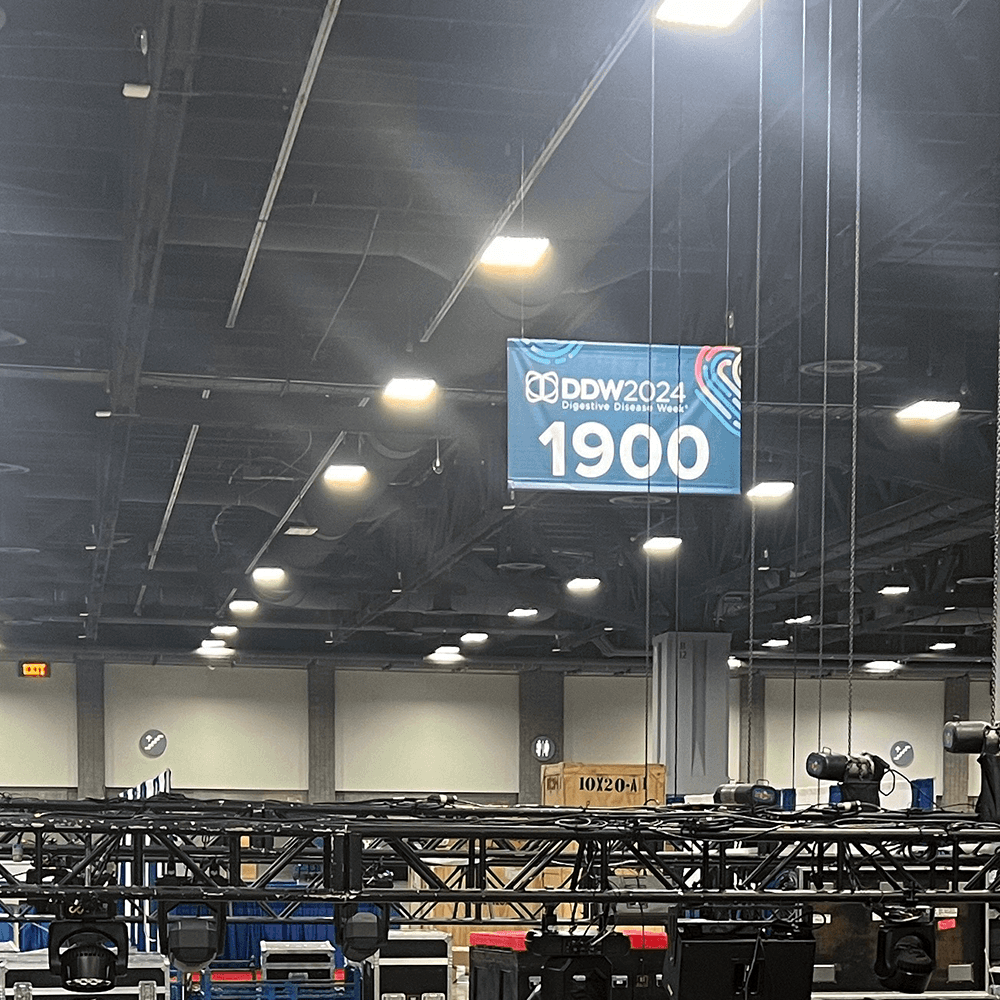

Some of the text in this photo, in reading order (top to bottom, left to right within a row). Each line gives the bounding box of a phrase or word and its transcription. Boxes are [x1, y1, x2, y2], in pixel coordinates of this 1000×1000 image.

[561, 378, 686, 403] DDW2024
[562, 400, 610, 411] Digestive
[614, 402, 653, 412] Disease
[538, 421, 710, 480] 1900
